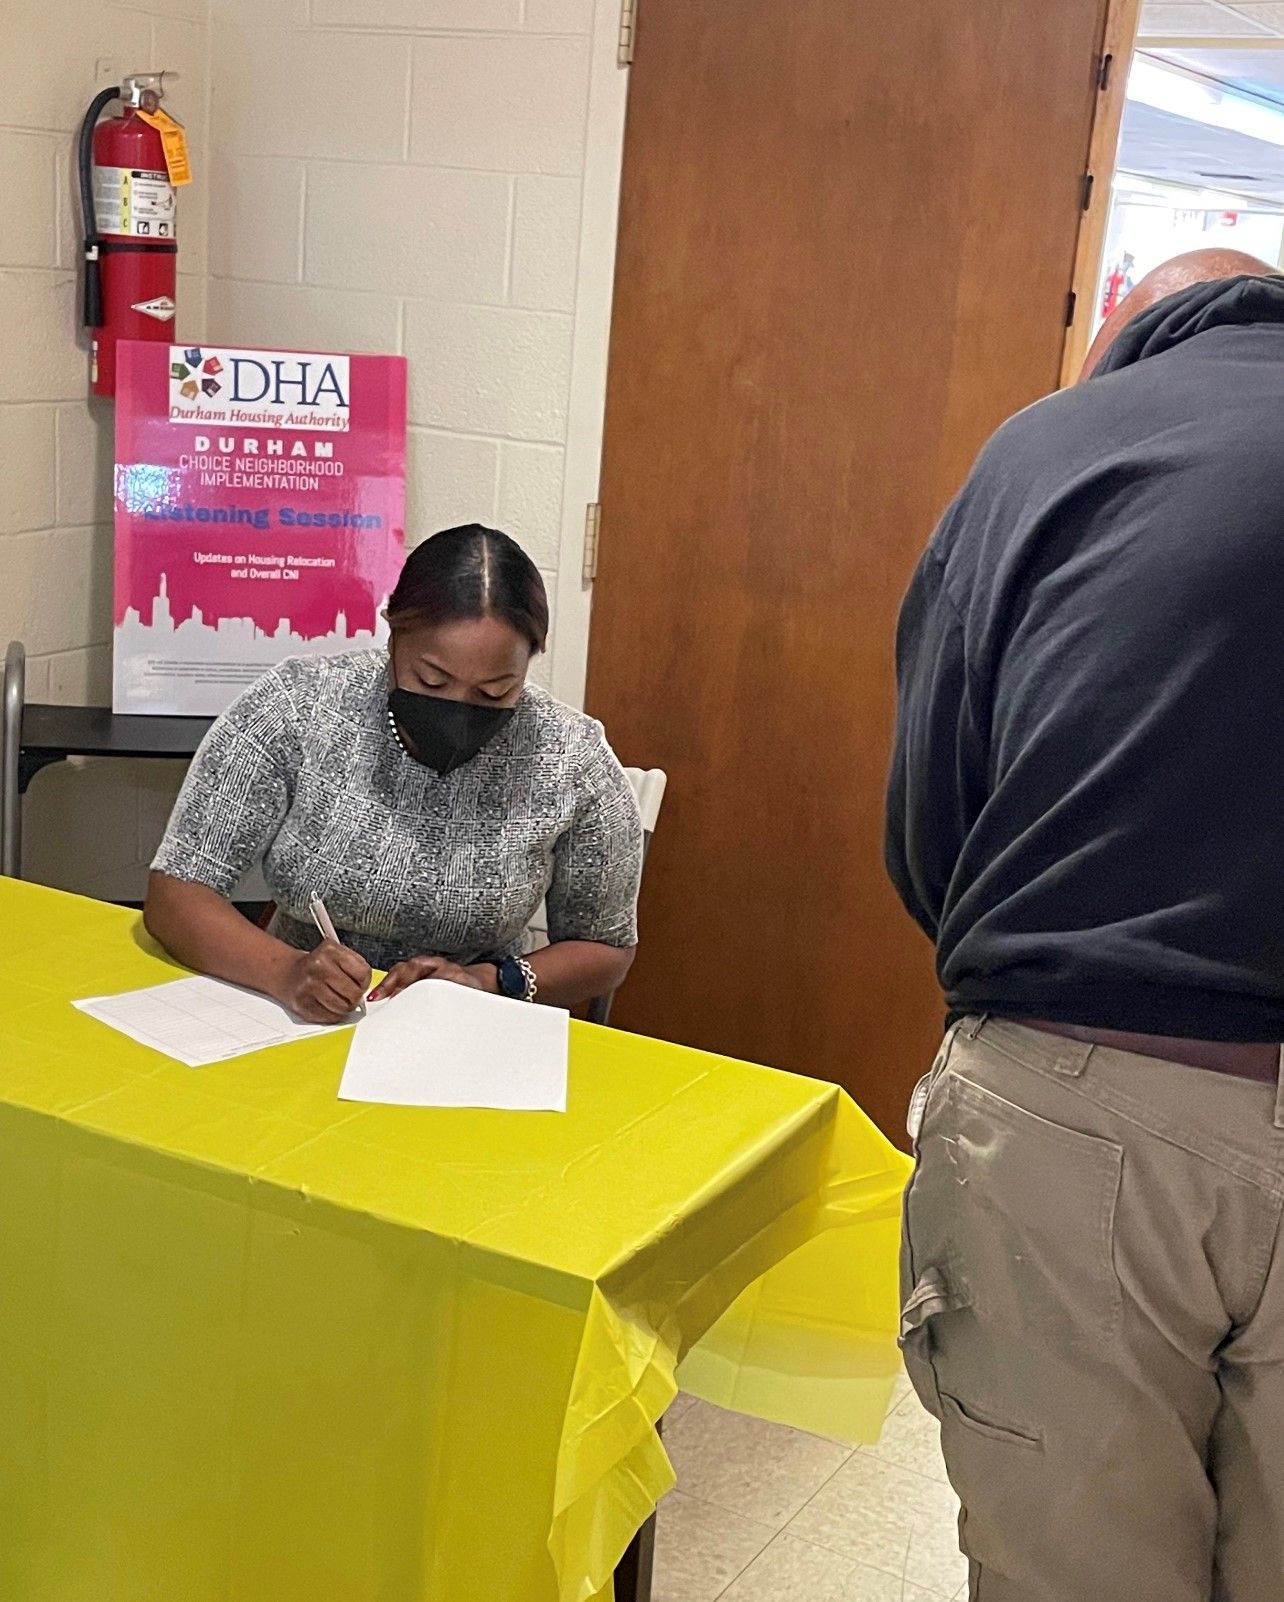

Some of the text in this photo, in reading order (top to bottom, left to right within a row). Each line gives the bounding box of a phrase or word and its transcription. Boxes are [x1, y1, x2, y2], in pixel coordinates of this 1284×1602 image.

[123, 175, 129, 185] A
[123, 197, 128, 207] B
[123, 219, 128, 228] C
[229, 358, 349, 407] DHA
[171, 406, 349, 432] Durham Housing Authority
[195, 435, 334, 458] DURHAM
[179, 454, 344, 476] CHOICE NEIGHBORHOOD
[200, 472, 319, 491] IMPLEMENTATION
[278, 507, 381, 529] Session
[193, 552, 336, 567] Updates on Housing Relocation
[230, 569, 248, 578] and
[249, 568, 281, 580] Overall
